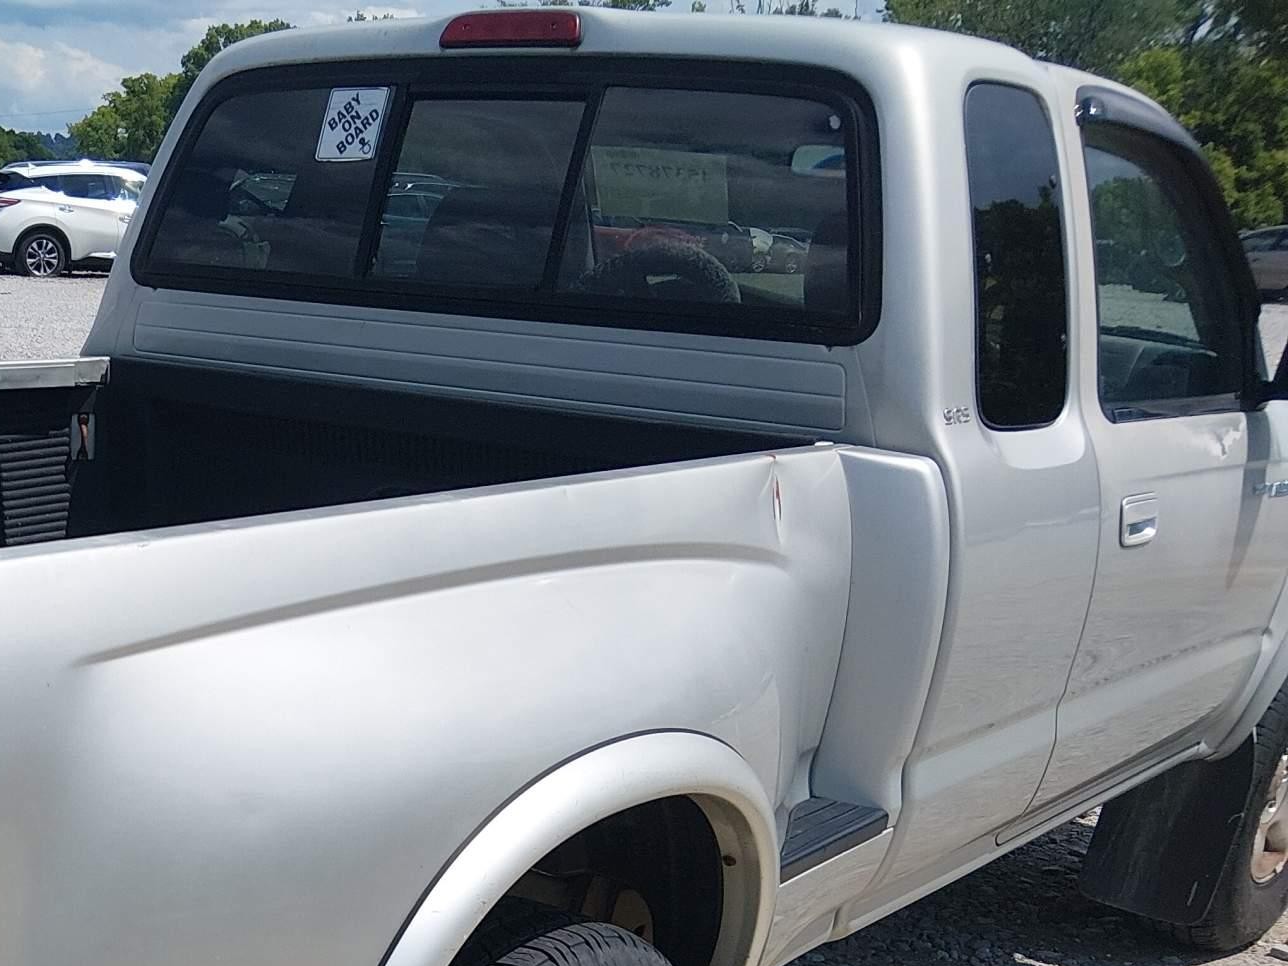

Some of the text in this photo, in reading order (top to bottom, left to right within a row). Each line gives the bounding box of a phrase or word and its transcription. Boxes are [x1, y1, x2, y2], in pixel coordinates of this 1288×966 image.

[327, 92, 361, 132] BABY
[335, 108, 380, 155] BOARD
[341, 110, 362, 133] ON
